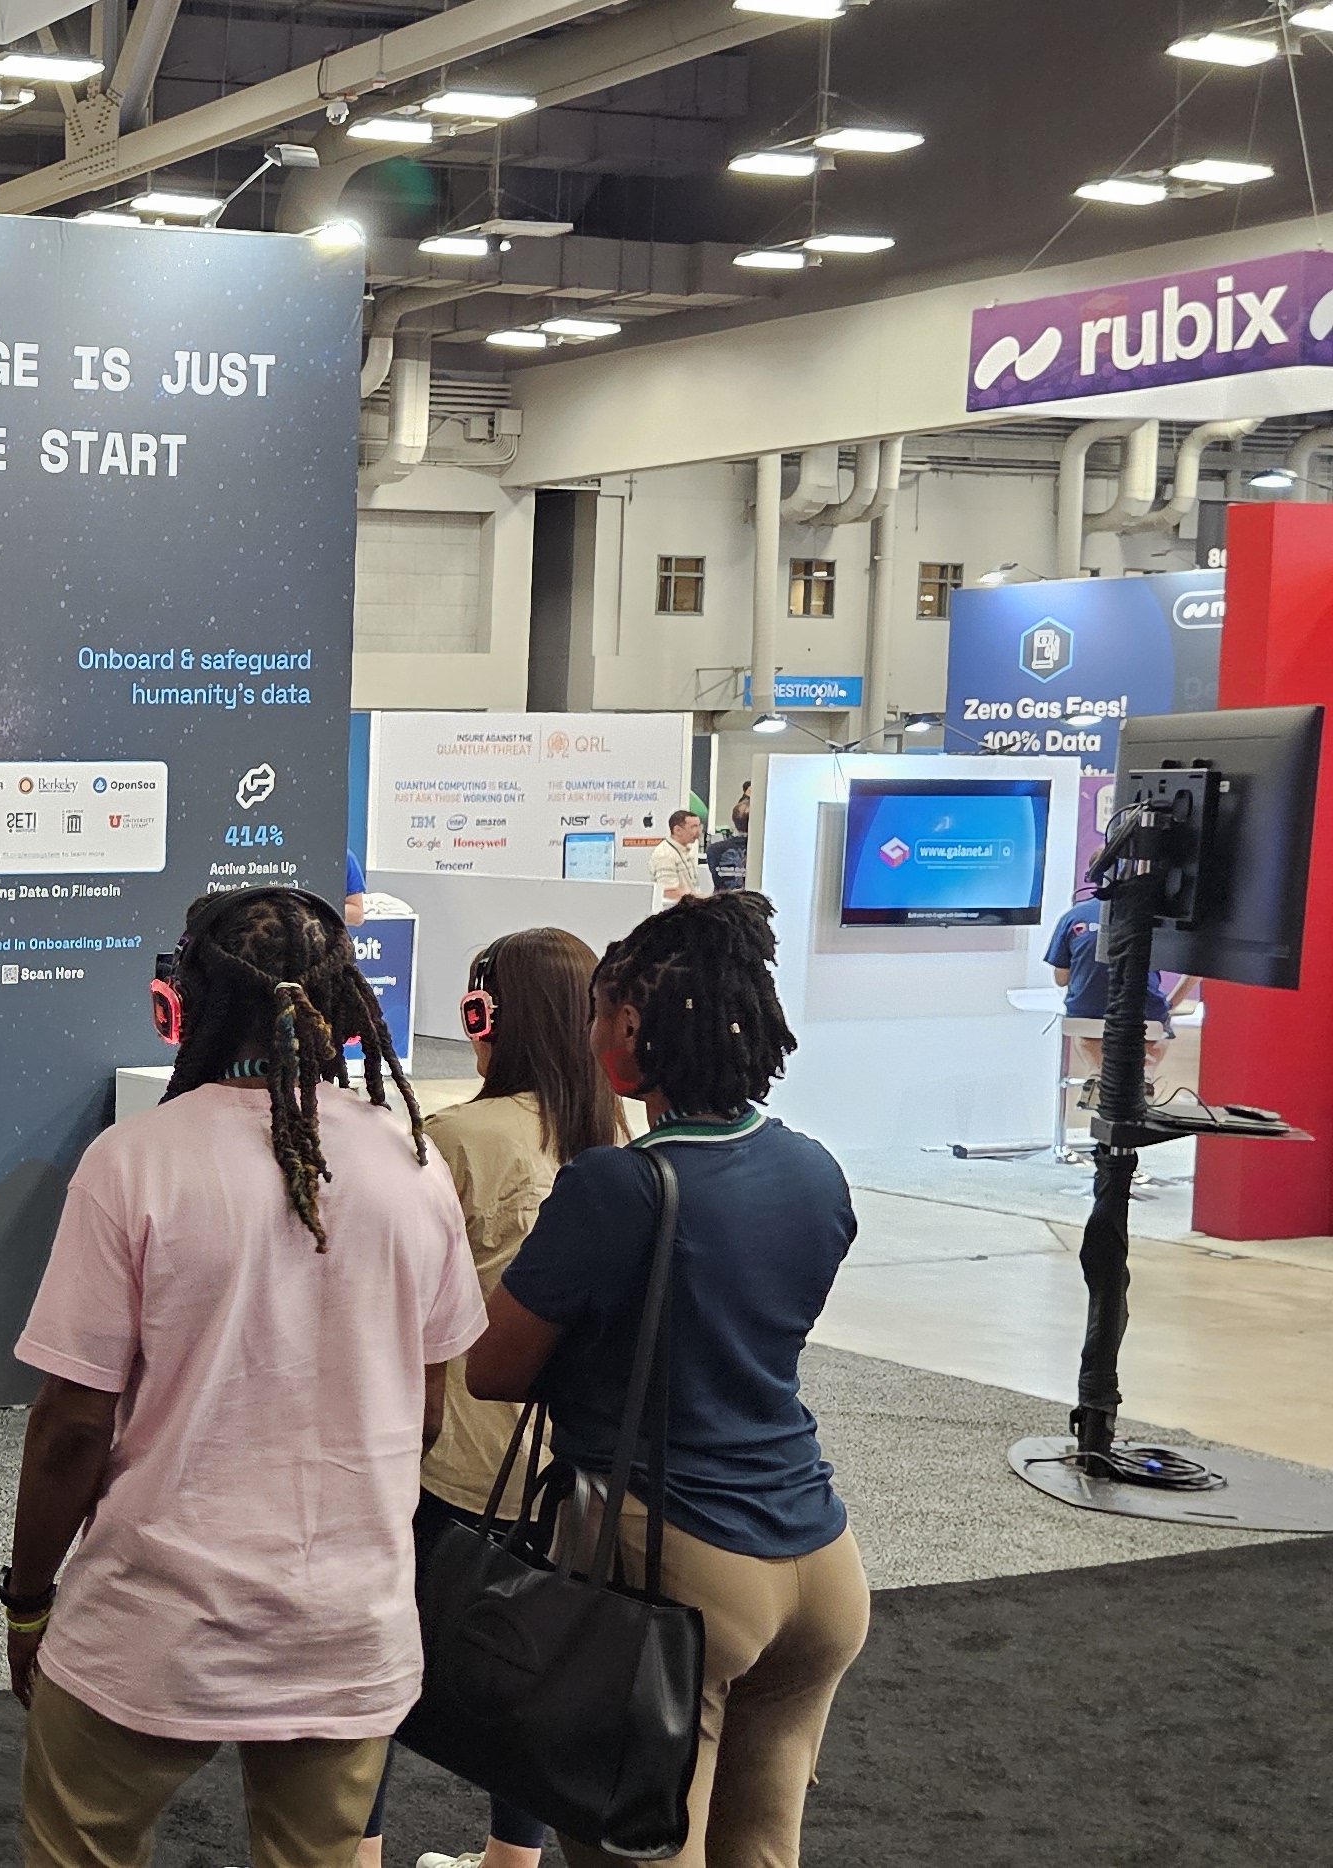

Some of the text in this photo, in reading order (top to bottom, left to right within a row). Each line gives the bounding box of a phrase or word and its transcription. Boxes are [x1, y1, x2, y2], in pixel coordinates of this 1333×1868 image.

[1080, 276, 1289, 376] rubix
[73, 345, 131, 392] IS
[162, 350, 276, 397] JUST
[40, 428, 187, 477] START
[78, 647, 311, 676] Onboard & safeguard
[132, 683, 311, 710] humanity's data
[963, 695, 1127, 720] Zero Gas Fees!
[457, 734, 532, 742] INSURE AGAINST THE
[575, 736, 611, 752] QRL
[984, 731, 1101, 752] 100% Data
[437, 744, 532, 755] QUANTUM THREAT
[38, 778, 78, 794] Berkeley
[110, 781, 156, 792] OpenSea
[395, 781, 435, 790] QUANTUM
[438, 781, 486, 790] COMPUTING
[565, 781, 604, 790] QUANTUM
[607, 781, 635, 789] THREAT
[463, 794, 501, 803] WORKING
[504, 794, 515, 802] ON
[411, 816, 435, 828] IBM
[561, 815, 590, 826] NIST
[600, 814, 633, 828] Google
[225, 825, 284, 846] 414%
[407, 837, 441, 851] Google
[454, 838, 507, 849] Honeywell
[209, 862, 297, 876] Active Deals Up
[435, 861, 473, 870] Tencent
[19, 885, 49, 898] Data
[52, 885, 69, 898] On
[72, 884, 121, 898] Filecoin
[14, 938, 26, 950] In
[29, 937, 102, 951] Onboarding
[106, 936, 142, 948] Data?
[21, 967, 84, 980] Scan Here
